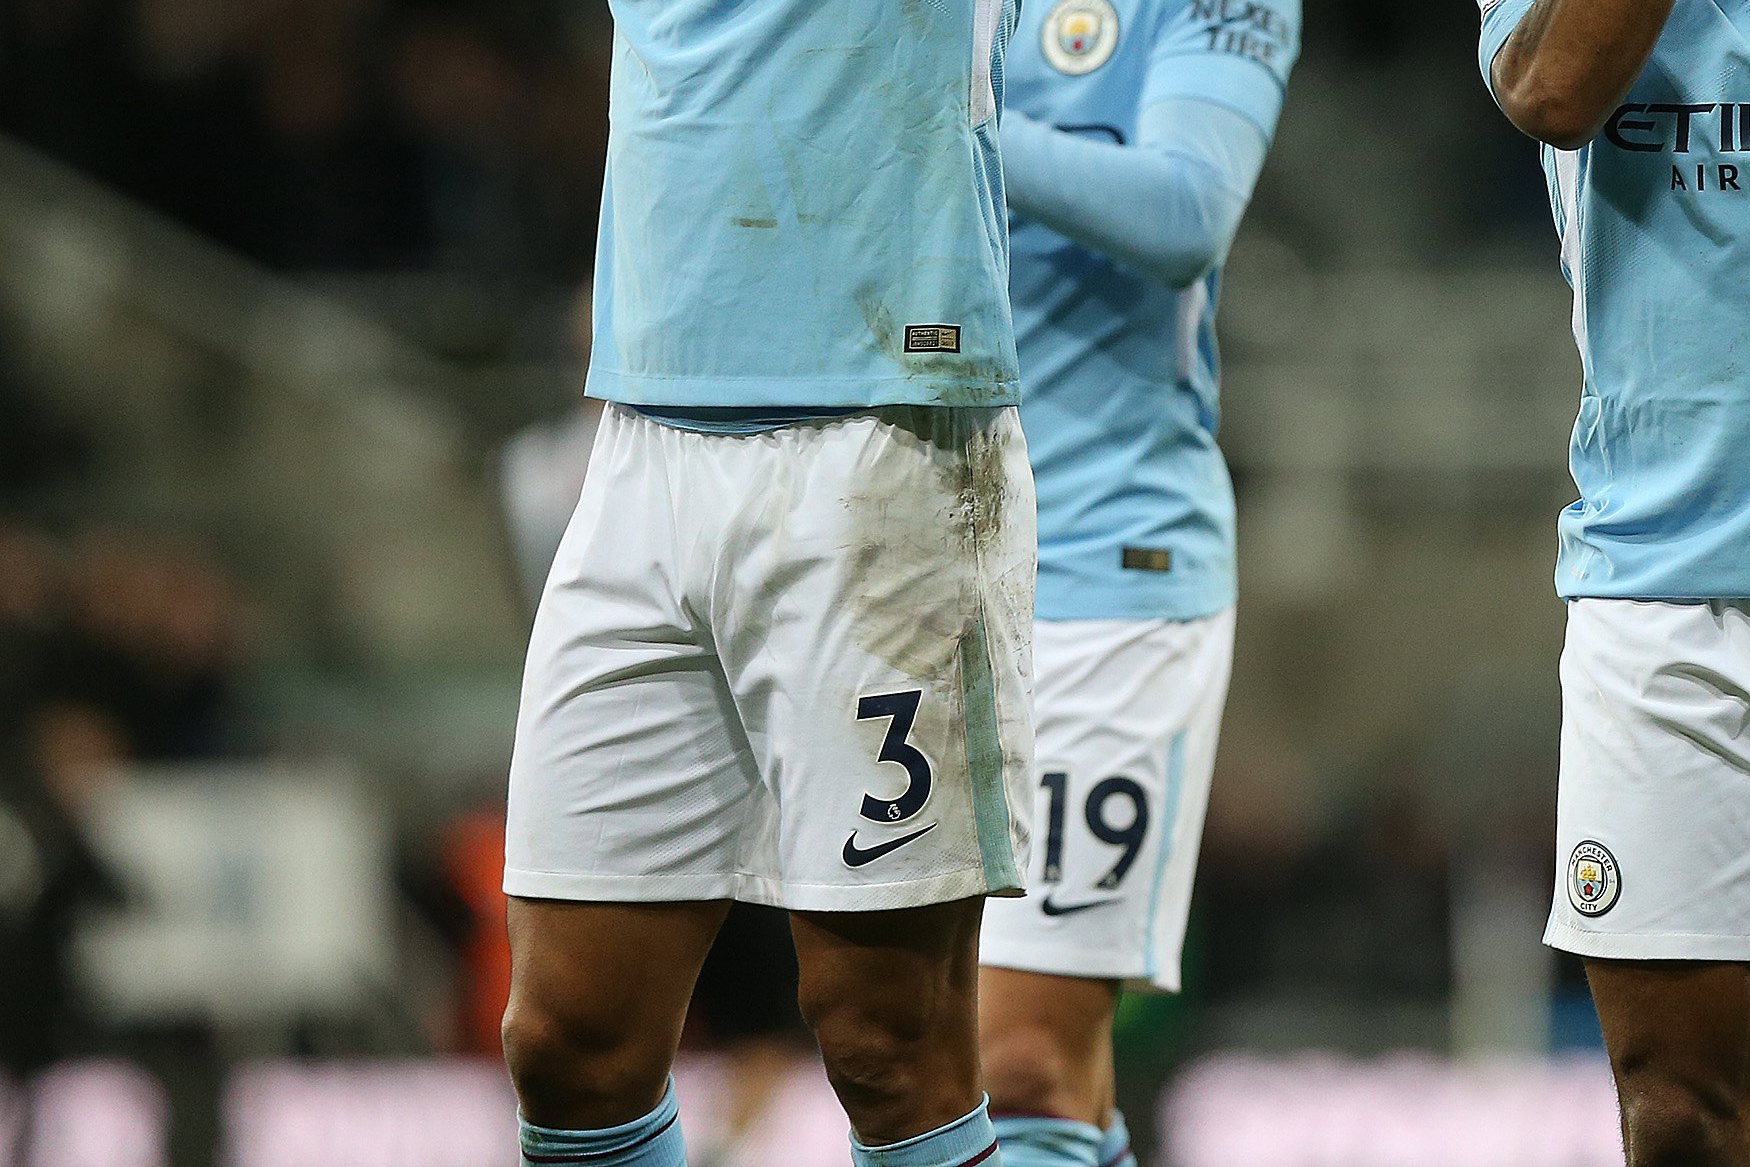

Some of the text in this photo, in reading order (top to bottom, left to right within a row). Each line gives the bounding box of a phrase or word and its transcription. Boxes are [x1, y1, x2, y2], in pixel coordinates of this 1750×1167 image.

[856, 689, 933, 823] 3
[1040, 771, 1149, 889] 19
[1571, 846, 1613, 872] MANCHESTER
[1580, 902, 1598, 911] CITY
